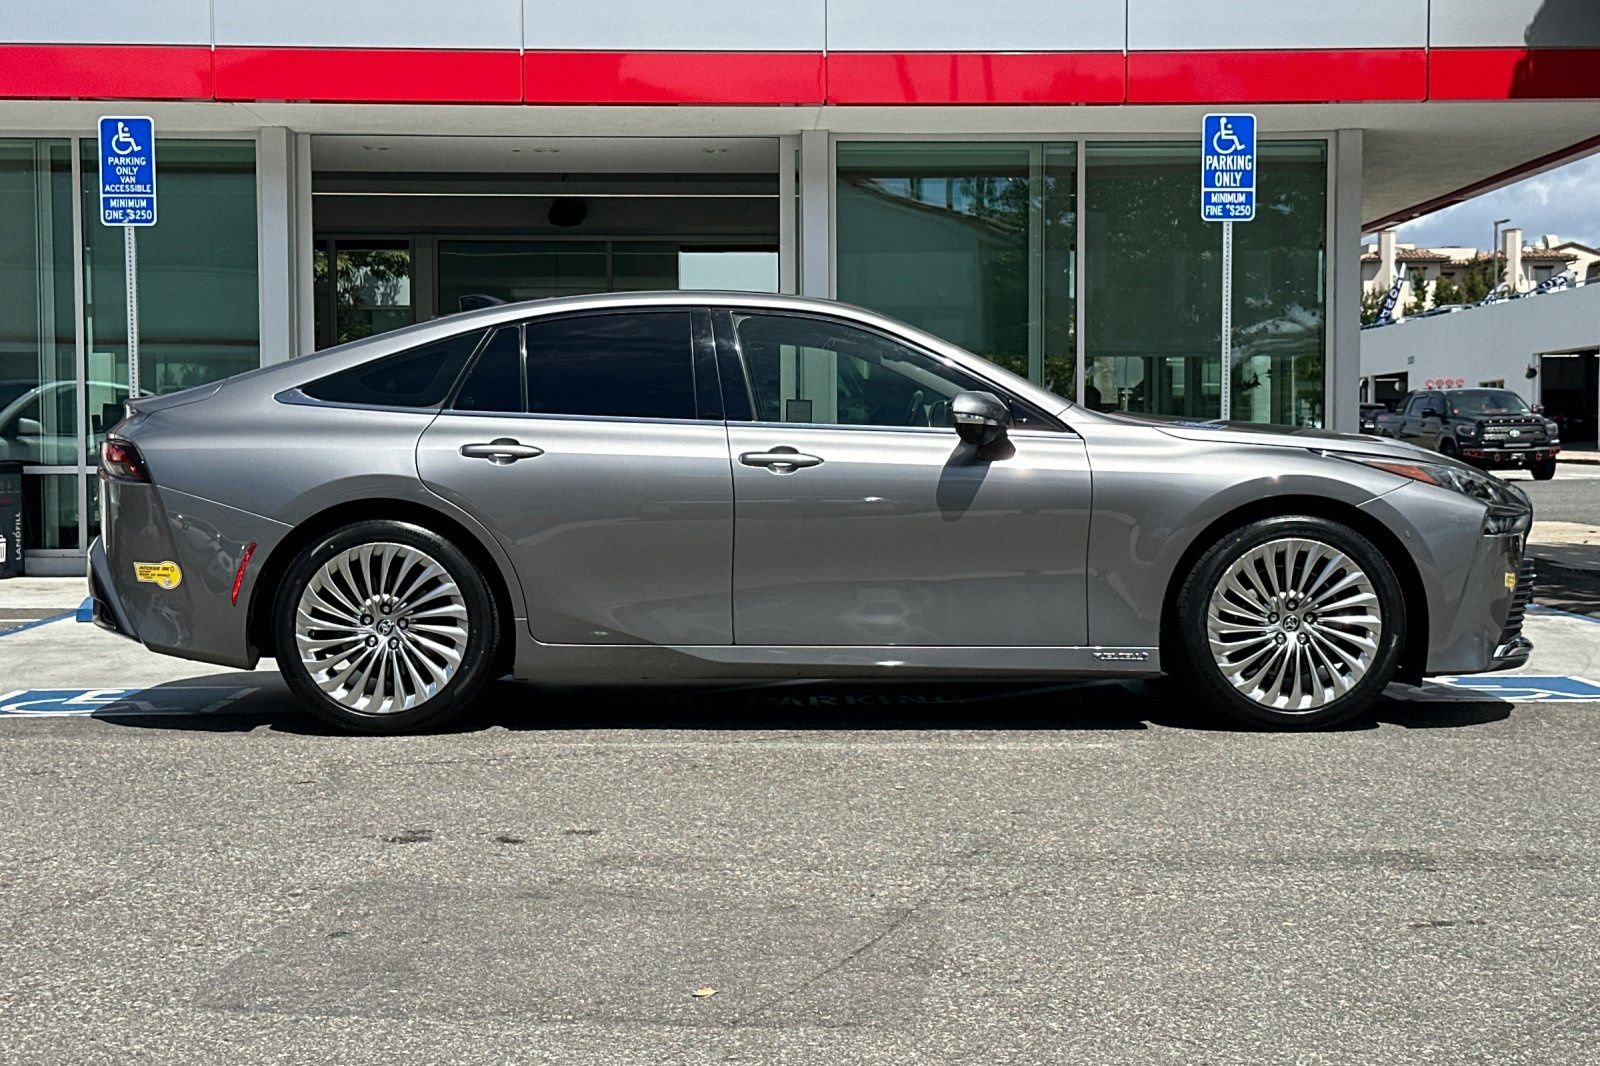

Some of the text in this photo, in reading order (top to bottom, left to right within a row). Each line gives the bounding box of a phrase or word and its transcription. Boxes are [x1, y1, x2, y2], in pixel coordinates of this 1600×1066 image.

[108, 157, 146, 165] PARKING
[1206, 155, 1252, 170] PARKING
[116, 167, 138, 175] ONLY
[1215, 172, 1242, 186] ONLY
[110, 199, 146, 207] MINIMUM
[1211, 193, 1246, 203] MINIMUM
[1206, 205, 1223, 216] FINE
